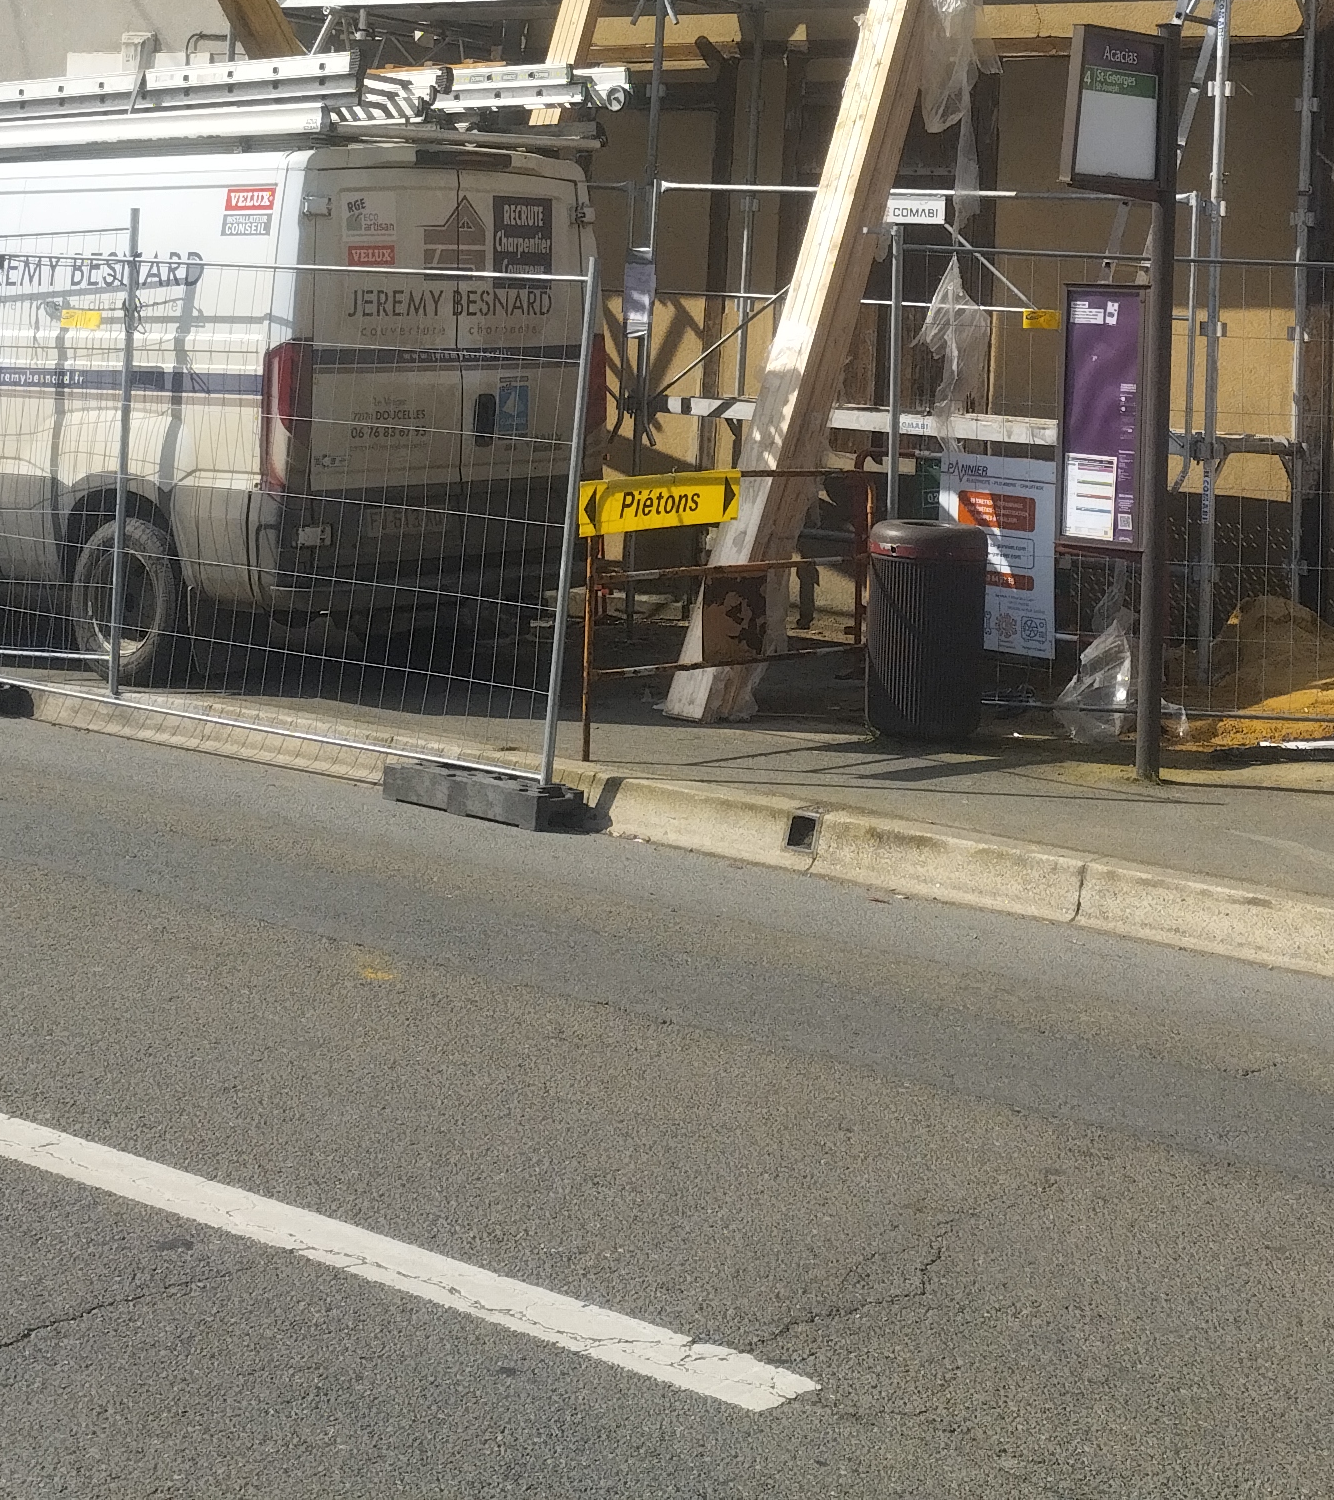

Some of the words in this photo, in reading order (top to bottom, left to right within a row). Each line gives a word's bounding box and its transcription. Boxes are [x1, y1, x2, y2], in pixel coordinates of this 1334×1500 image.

[1103, 46, 1138, 65] Acacias
[1083, 71, 1091, 85] 4
[1096, 71, 1136, 87] St-Georges
[231, 192, 270, 206] VELUX
[347, 198, 366, 213] RGE
[364, 213, 379, 221] ECO
[503, 204, 544, 227] RECRUTE
[893, 207, 938, 218] COMABI
[225, 223, 266, 234] CONSEIL
[364, 222, 395, 231] artisan
[495, 230, 551, 258] Charpentier
[351, 249, 391, 261] VELUX
[70, 250, 204, 287] BESNARD
[348, 289, 444, 317] JEREMY
[452, 289, 552, 317] BESNARD
[375, 409, 426, 420] DOUCELLES
[351, 427, 364, 438] 06
[368, 426, 380, 438] 76
[383, 426, 396, 437] 83
[948, 460, 988, 481] PANNIER
[619, 489, 701, 519] Piétons
